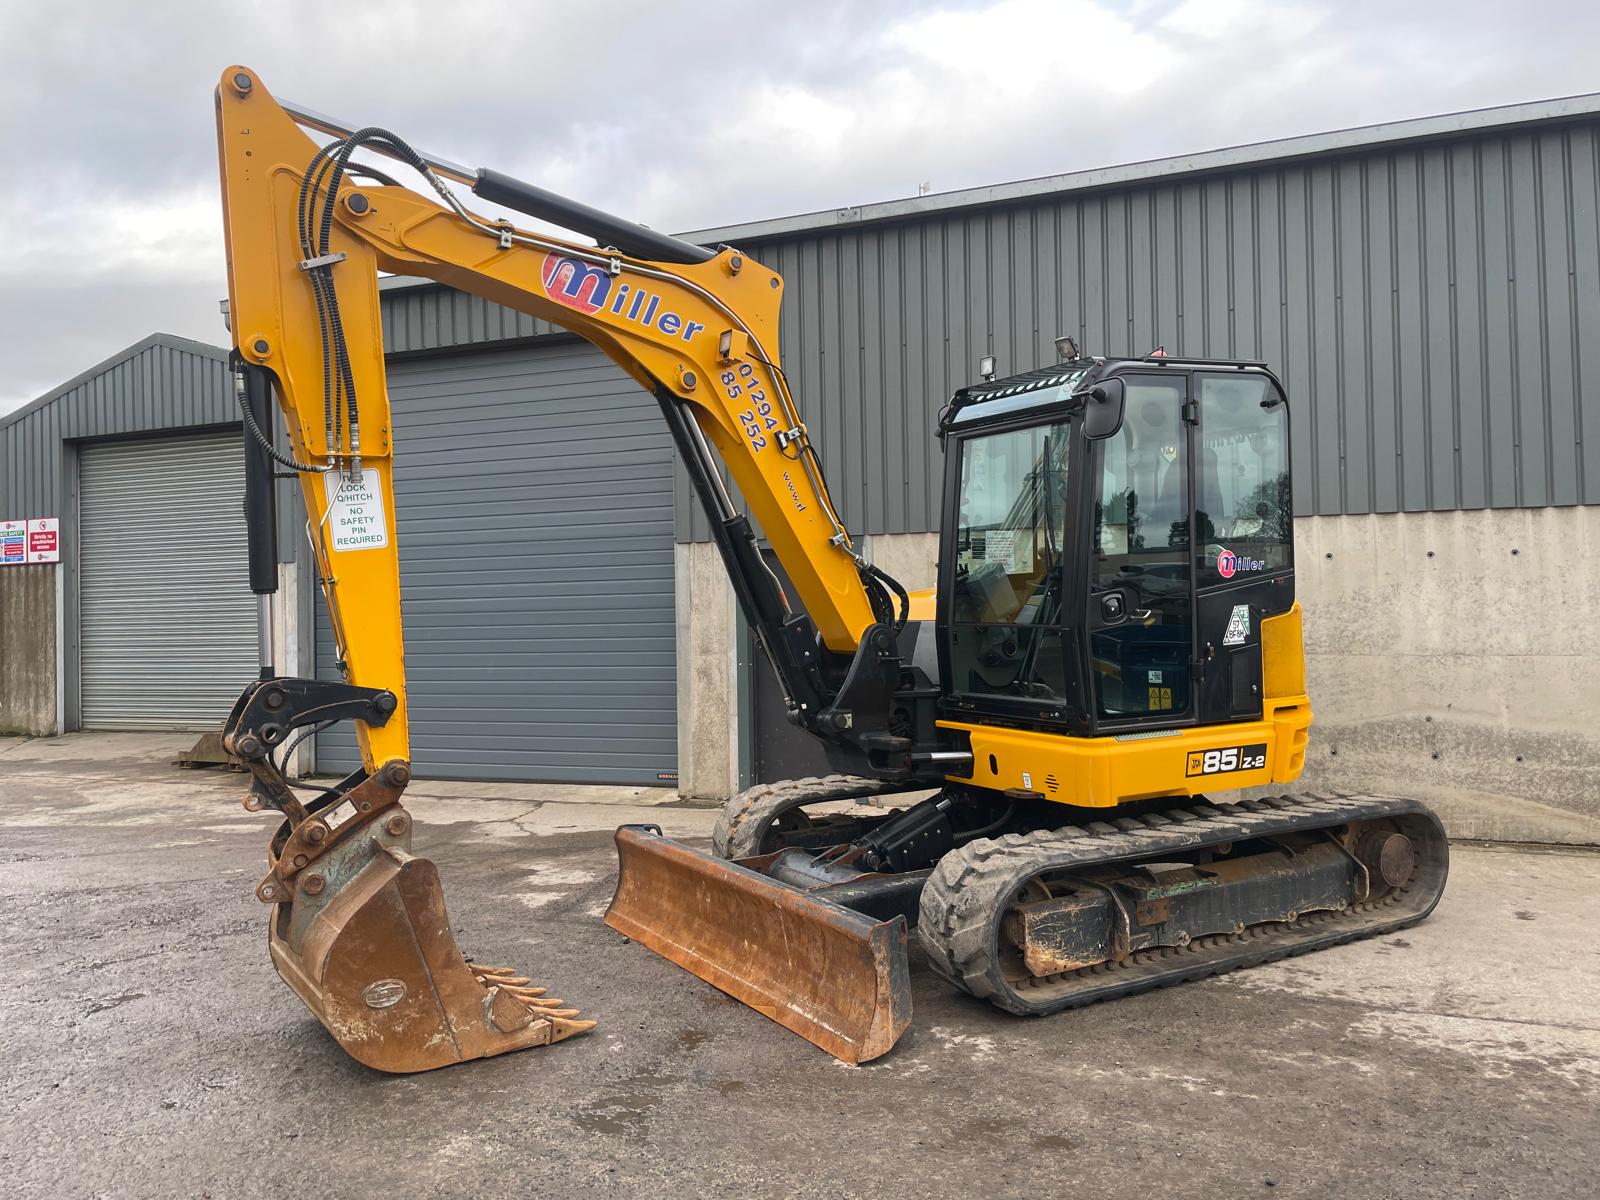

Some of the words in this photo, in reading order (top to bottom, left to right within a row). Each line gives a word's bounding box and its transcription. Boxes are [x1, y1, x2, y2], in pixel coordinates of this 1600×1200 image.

[738, 363, 778, 431] 01294
[721, 371, 743, 399] 85
[739, 410, 767, 453] 252
[341, 484, 366, 492] LOCK
[337, 493, 373, 502] Q/HITCH
[350, 507, 363, 515] NO
[340, 517, 374, 526] SAFETY
[337, 535, 383, 546] REQUIRED
[1203, 749, 1238, 773] 85
